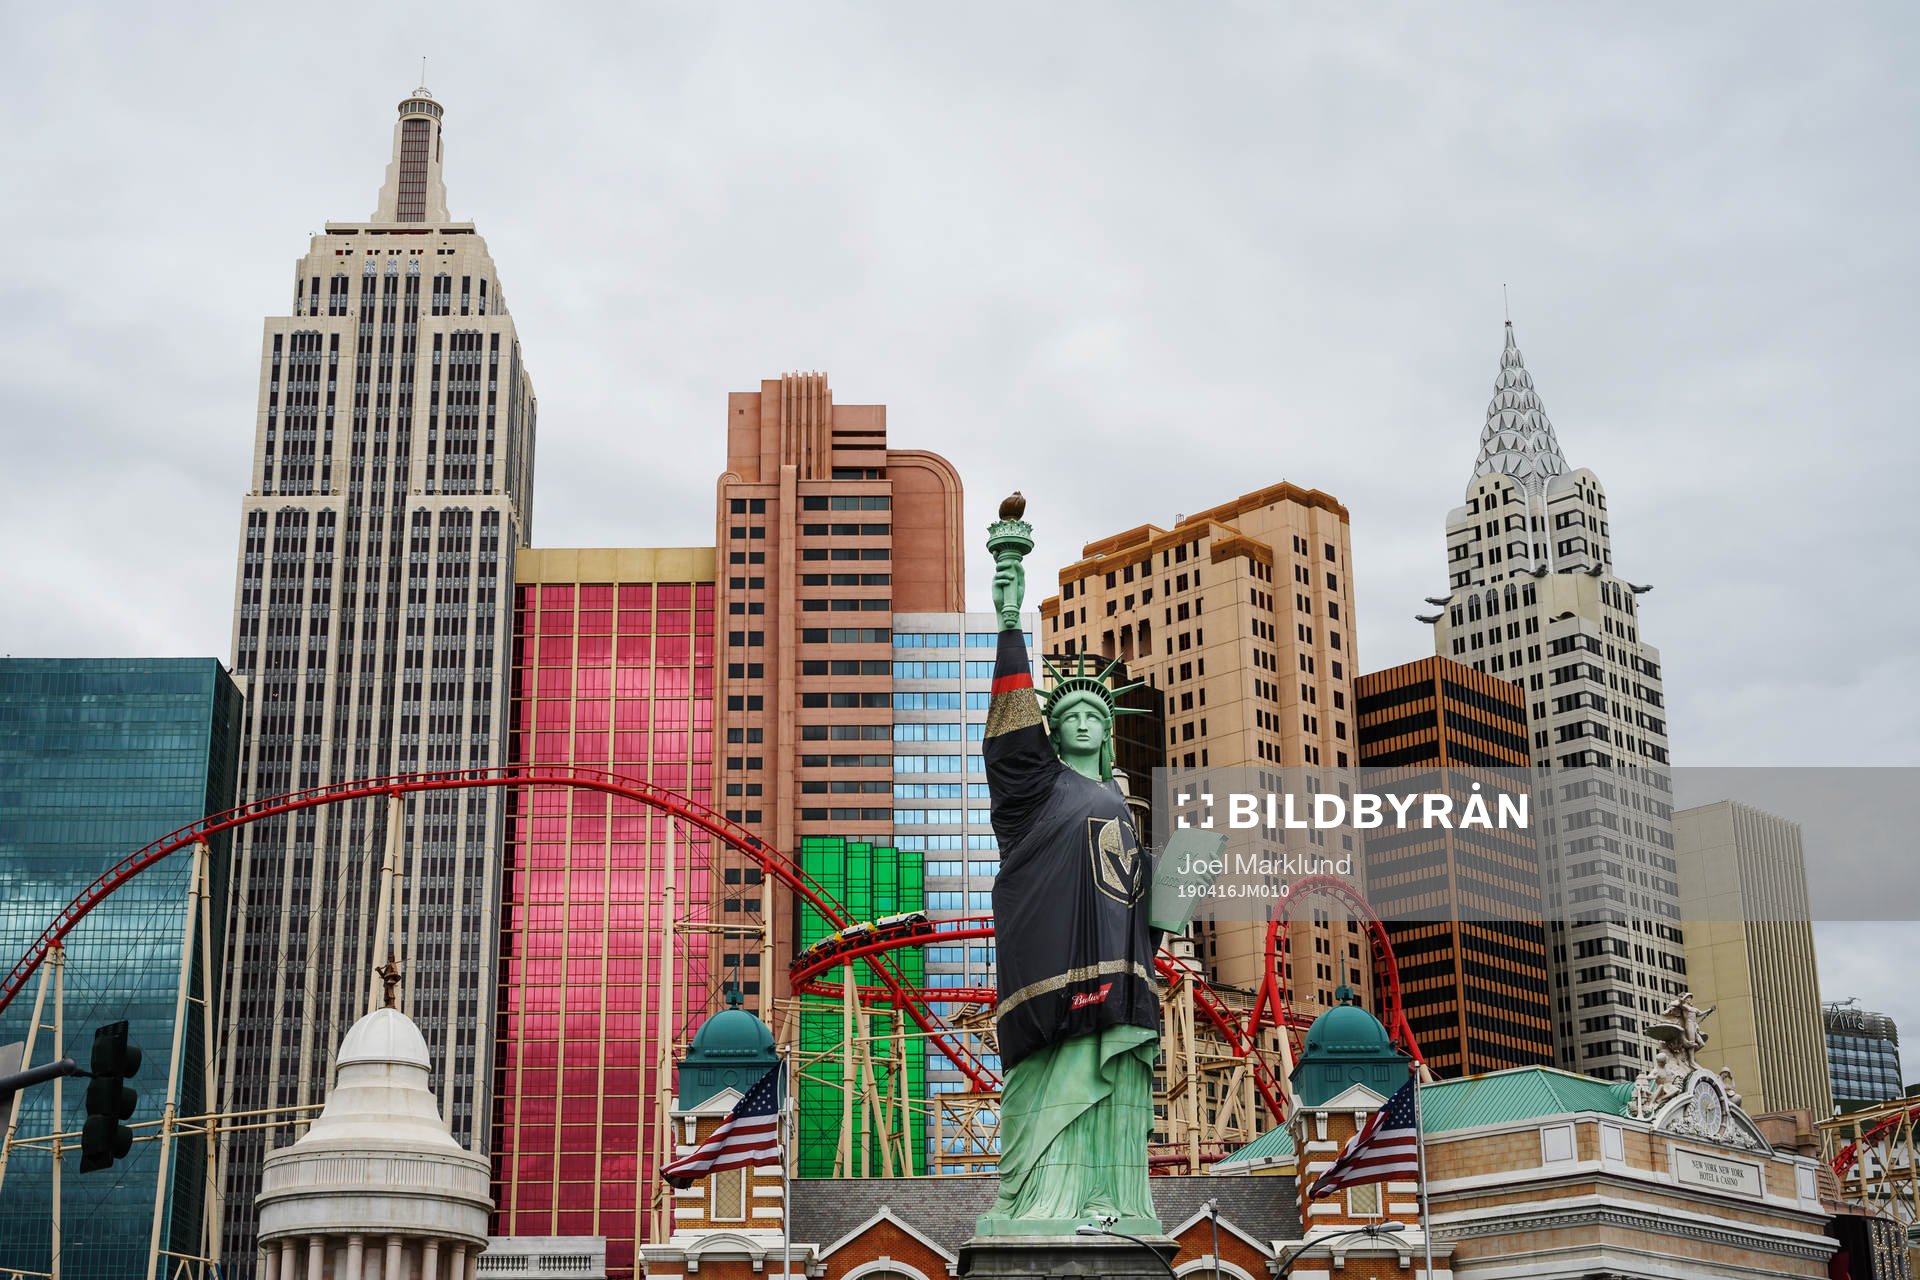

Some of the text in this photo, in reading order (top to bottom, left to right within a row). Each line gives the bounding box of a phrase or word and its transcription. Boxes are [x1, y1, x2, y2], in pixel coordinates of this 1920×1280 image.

[1691, 1160, 1745, 1178] NEW YORK NEW YORK
[1698, 1171, 1715, 1182] HOTEL
[1720, 1176, 1739, 1187] CASINO
